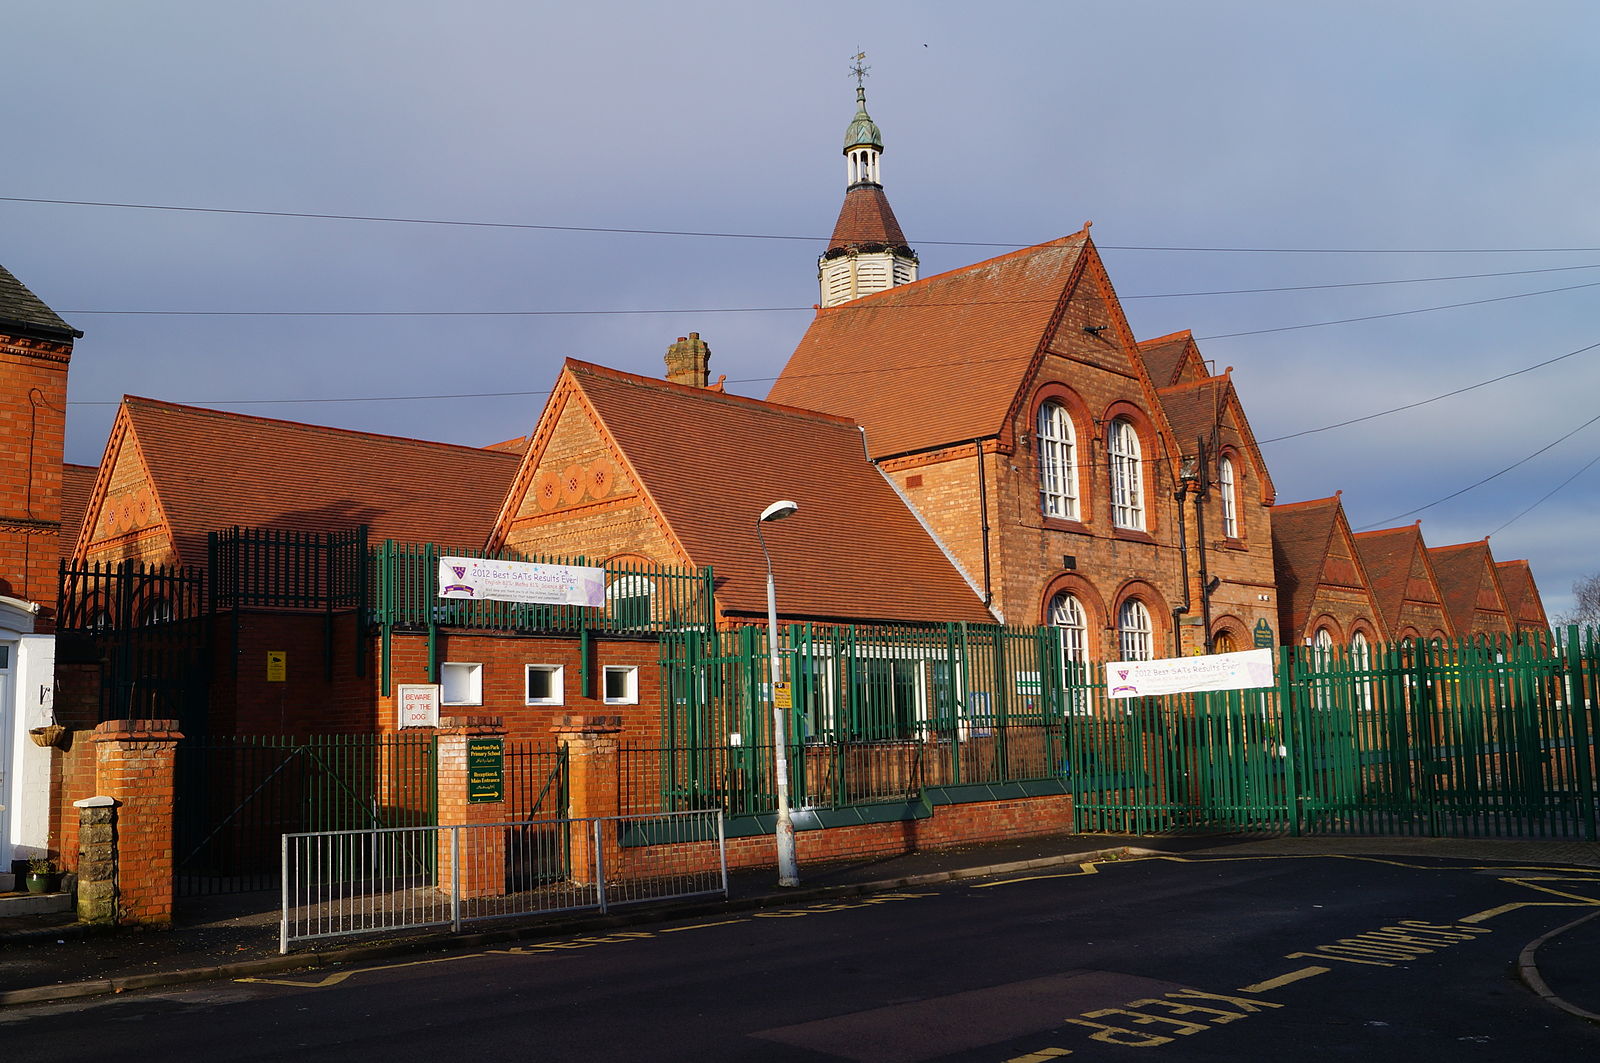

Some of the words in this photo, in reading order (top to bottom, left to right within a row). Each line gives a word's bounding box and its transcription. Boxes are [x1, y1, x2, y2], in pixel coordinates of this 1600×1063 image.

[472, 568, 490, 578] 2012
[493, 570, 510, 579] Best
[513, 572, 531, 581] SATs
[534, 574, 559, 583] Results
[562, 575, 578, 584] Ever!
[1170, 666, 1191, 674] SATs
[1282, 920, 1493, 967] SCHOOL
[1064, 988, 1285, 1048] KEEP
